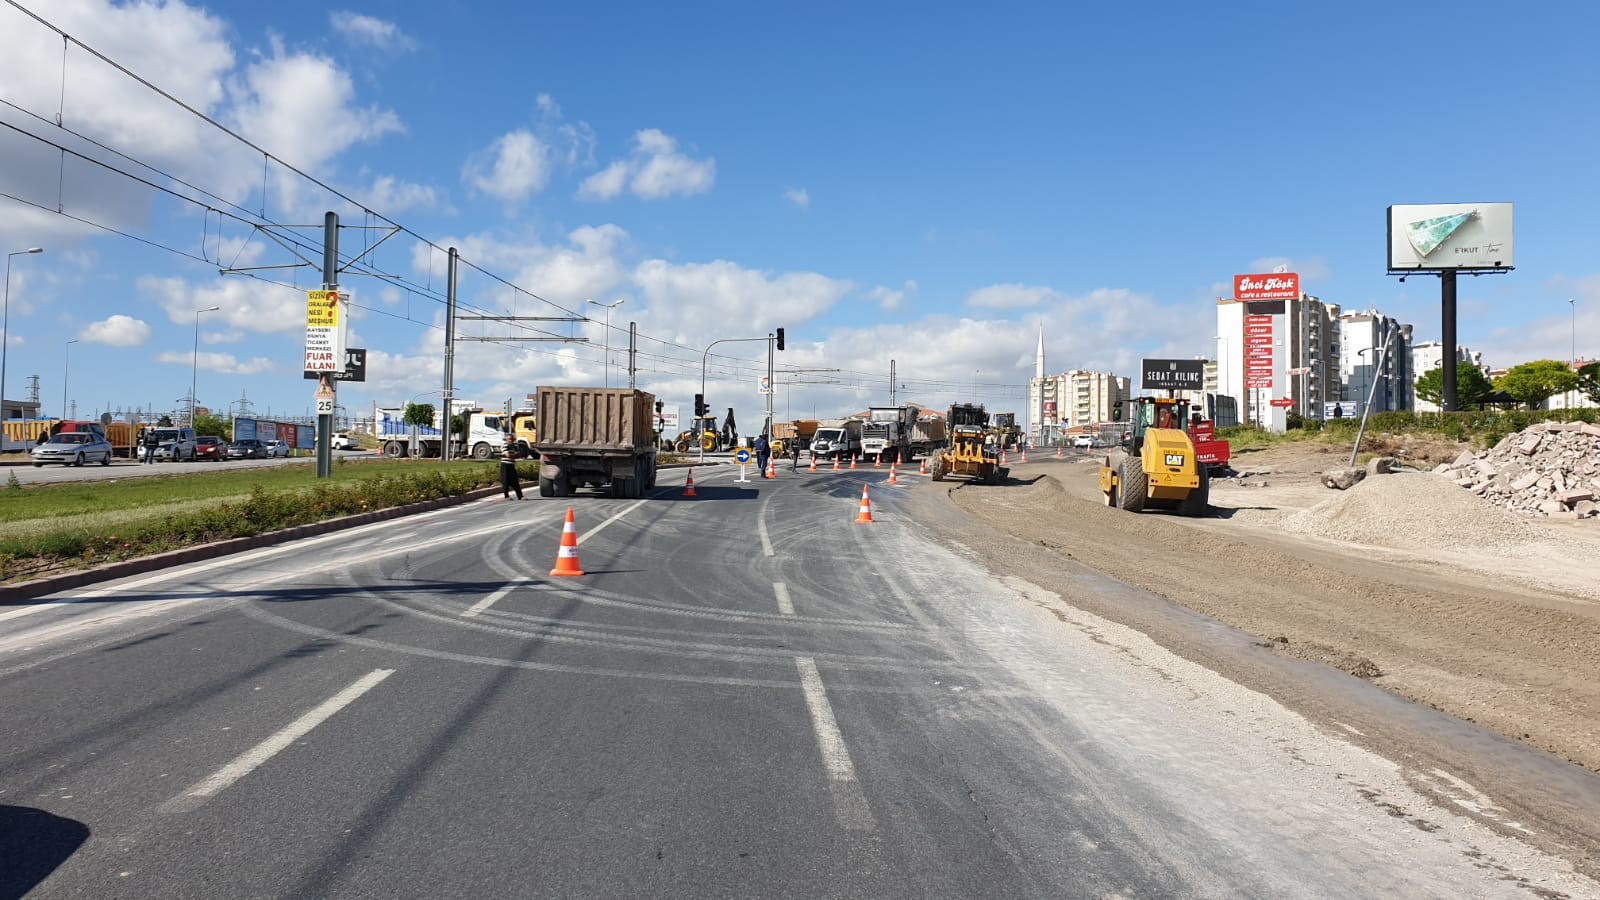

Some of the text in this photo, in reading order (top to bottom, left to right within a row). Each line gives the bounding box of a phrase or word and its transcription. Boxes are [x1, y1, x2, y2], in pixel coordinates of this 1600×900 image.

[1264, 277, 1294, 291] Köşk
[1147, 371, 1199, 382] SEDAT KILINÇ
[318, 401, 332, 411] 25
[1166, 455, 1183, 465] CAT
